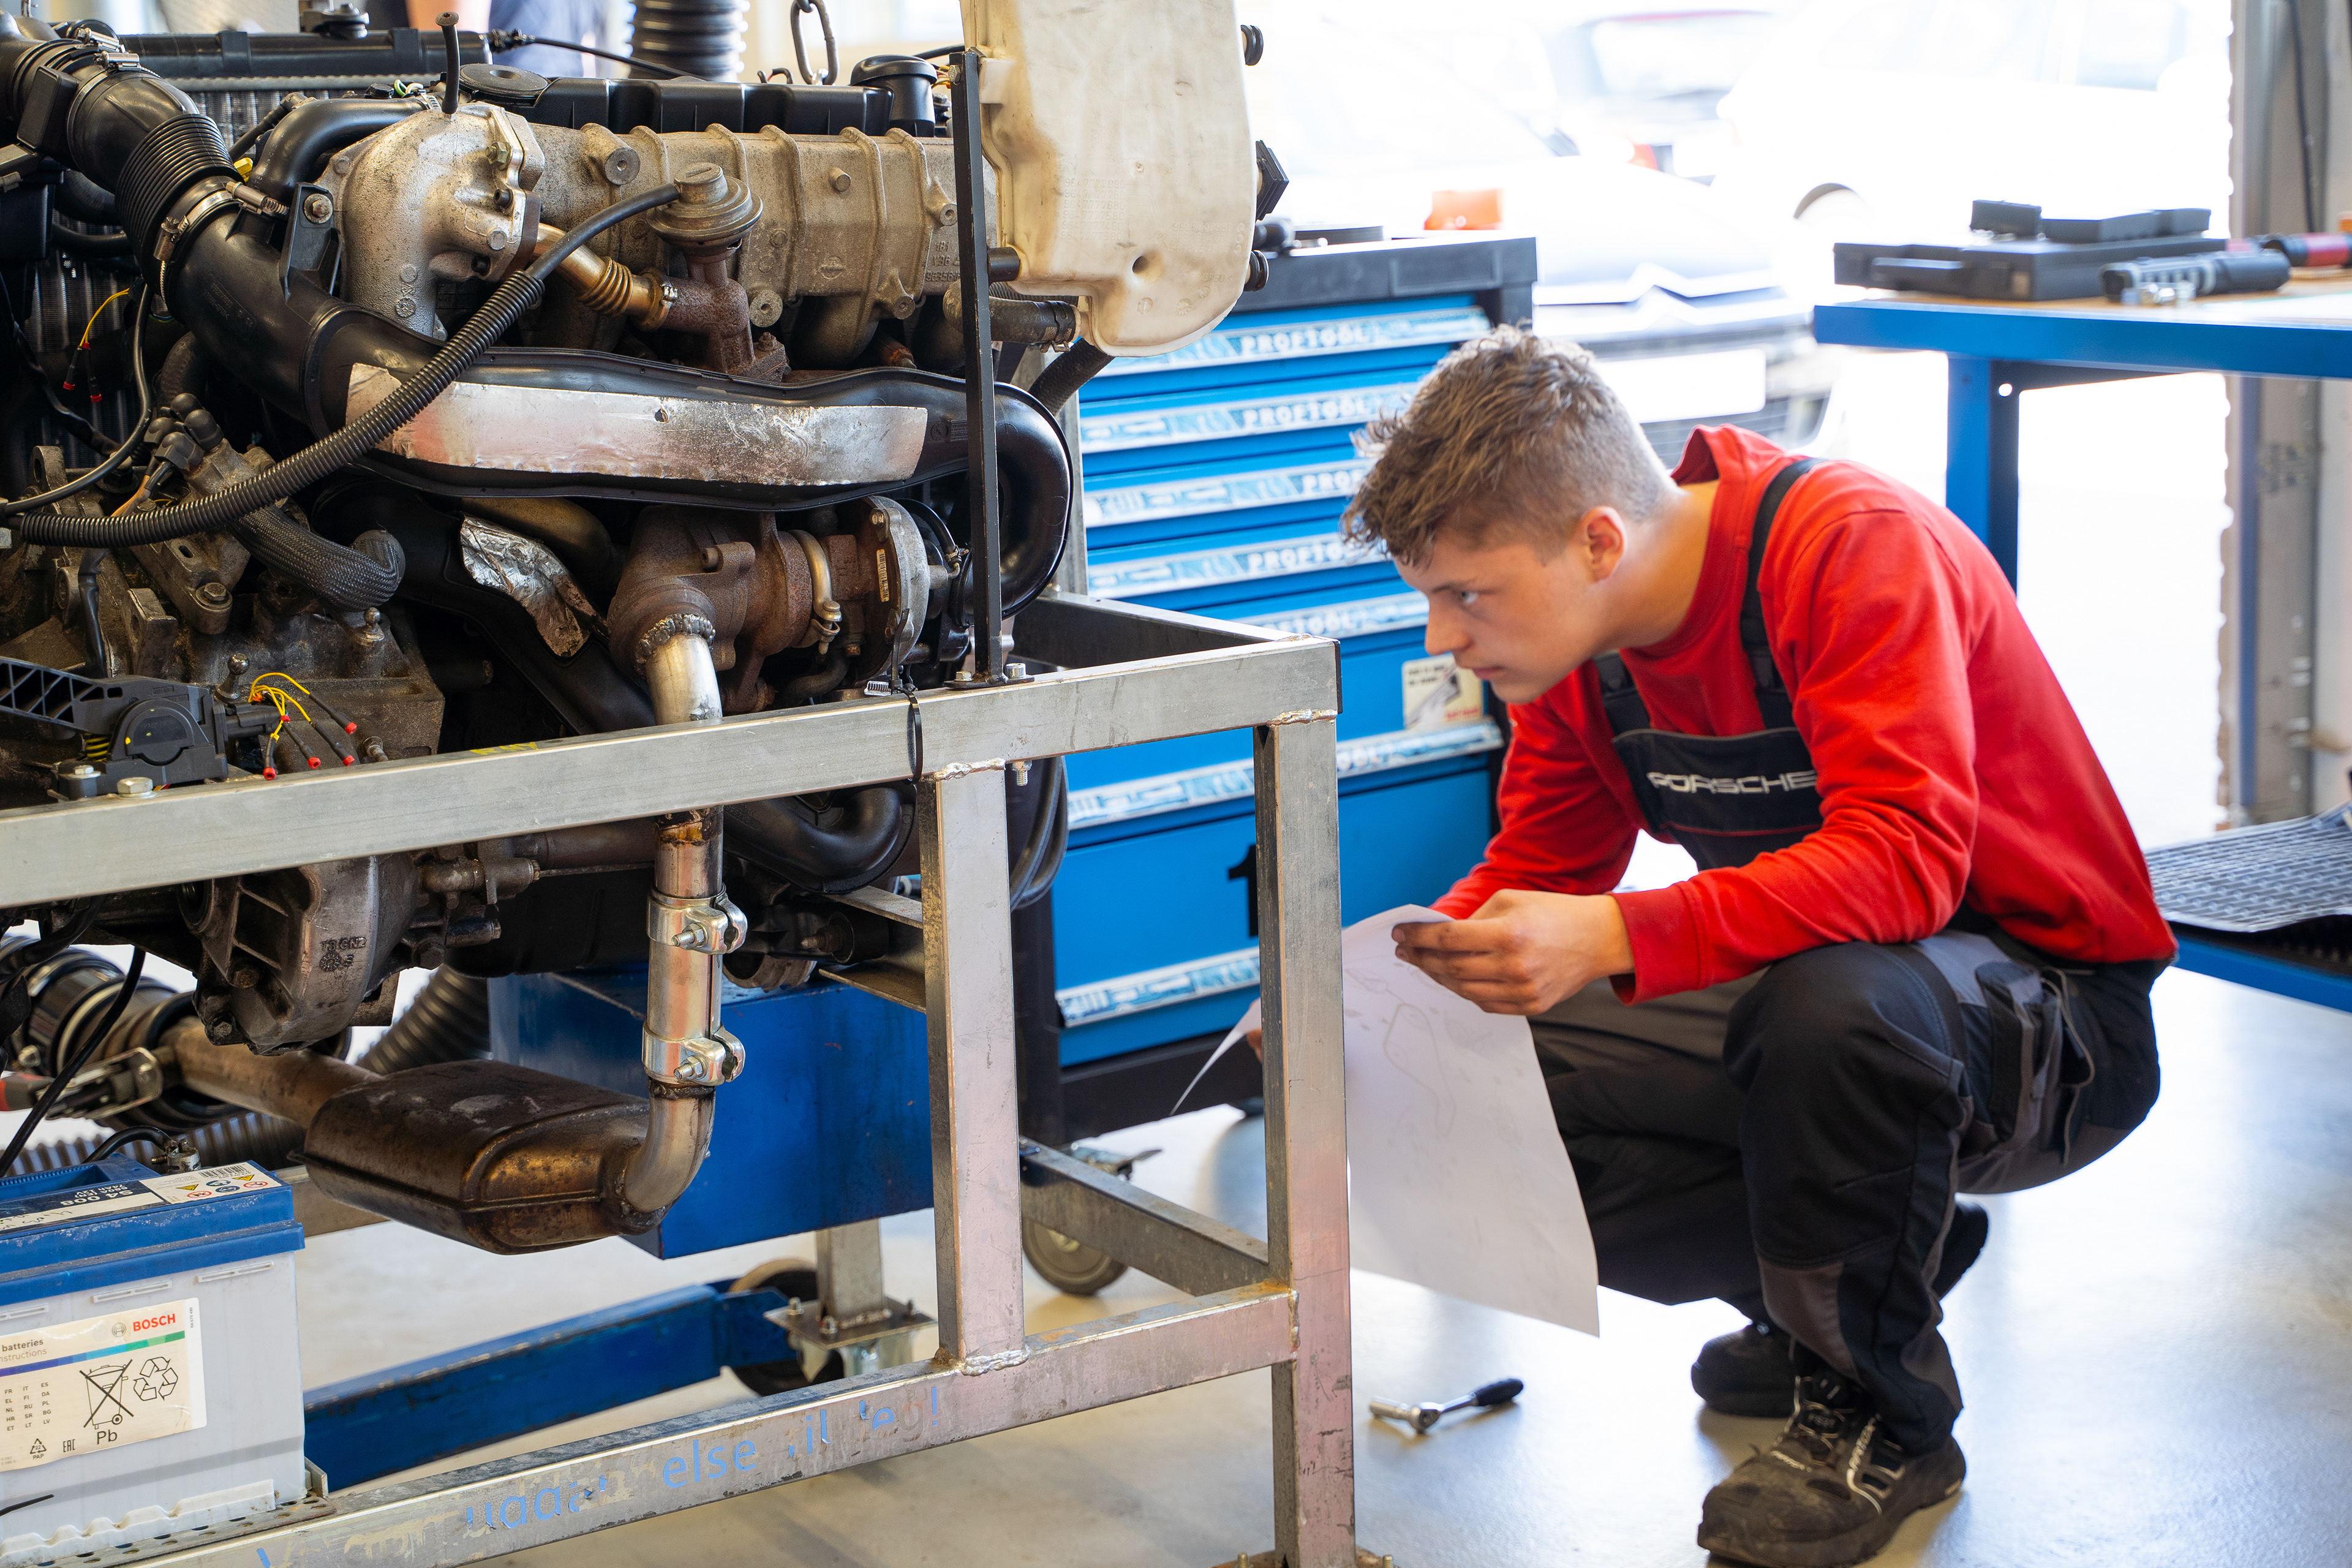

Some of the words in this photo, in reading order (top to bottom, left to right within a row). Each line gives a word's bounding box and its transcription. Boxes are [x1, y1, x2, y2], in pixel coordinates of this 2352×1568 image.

[1646, 769, 1818, 794] PORSCHE
[60, 1196, 100, 1205] 008
[105, 1189, 134, 1198] S4
[132, 1313, 176, 1332] BOSCH
[2, 1338, 45, 1352] batteries
[0, 1348, 47, 1363] nstructions
[96, 1429, 118, 1445] Pb
